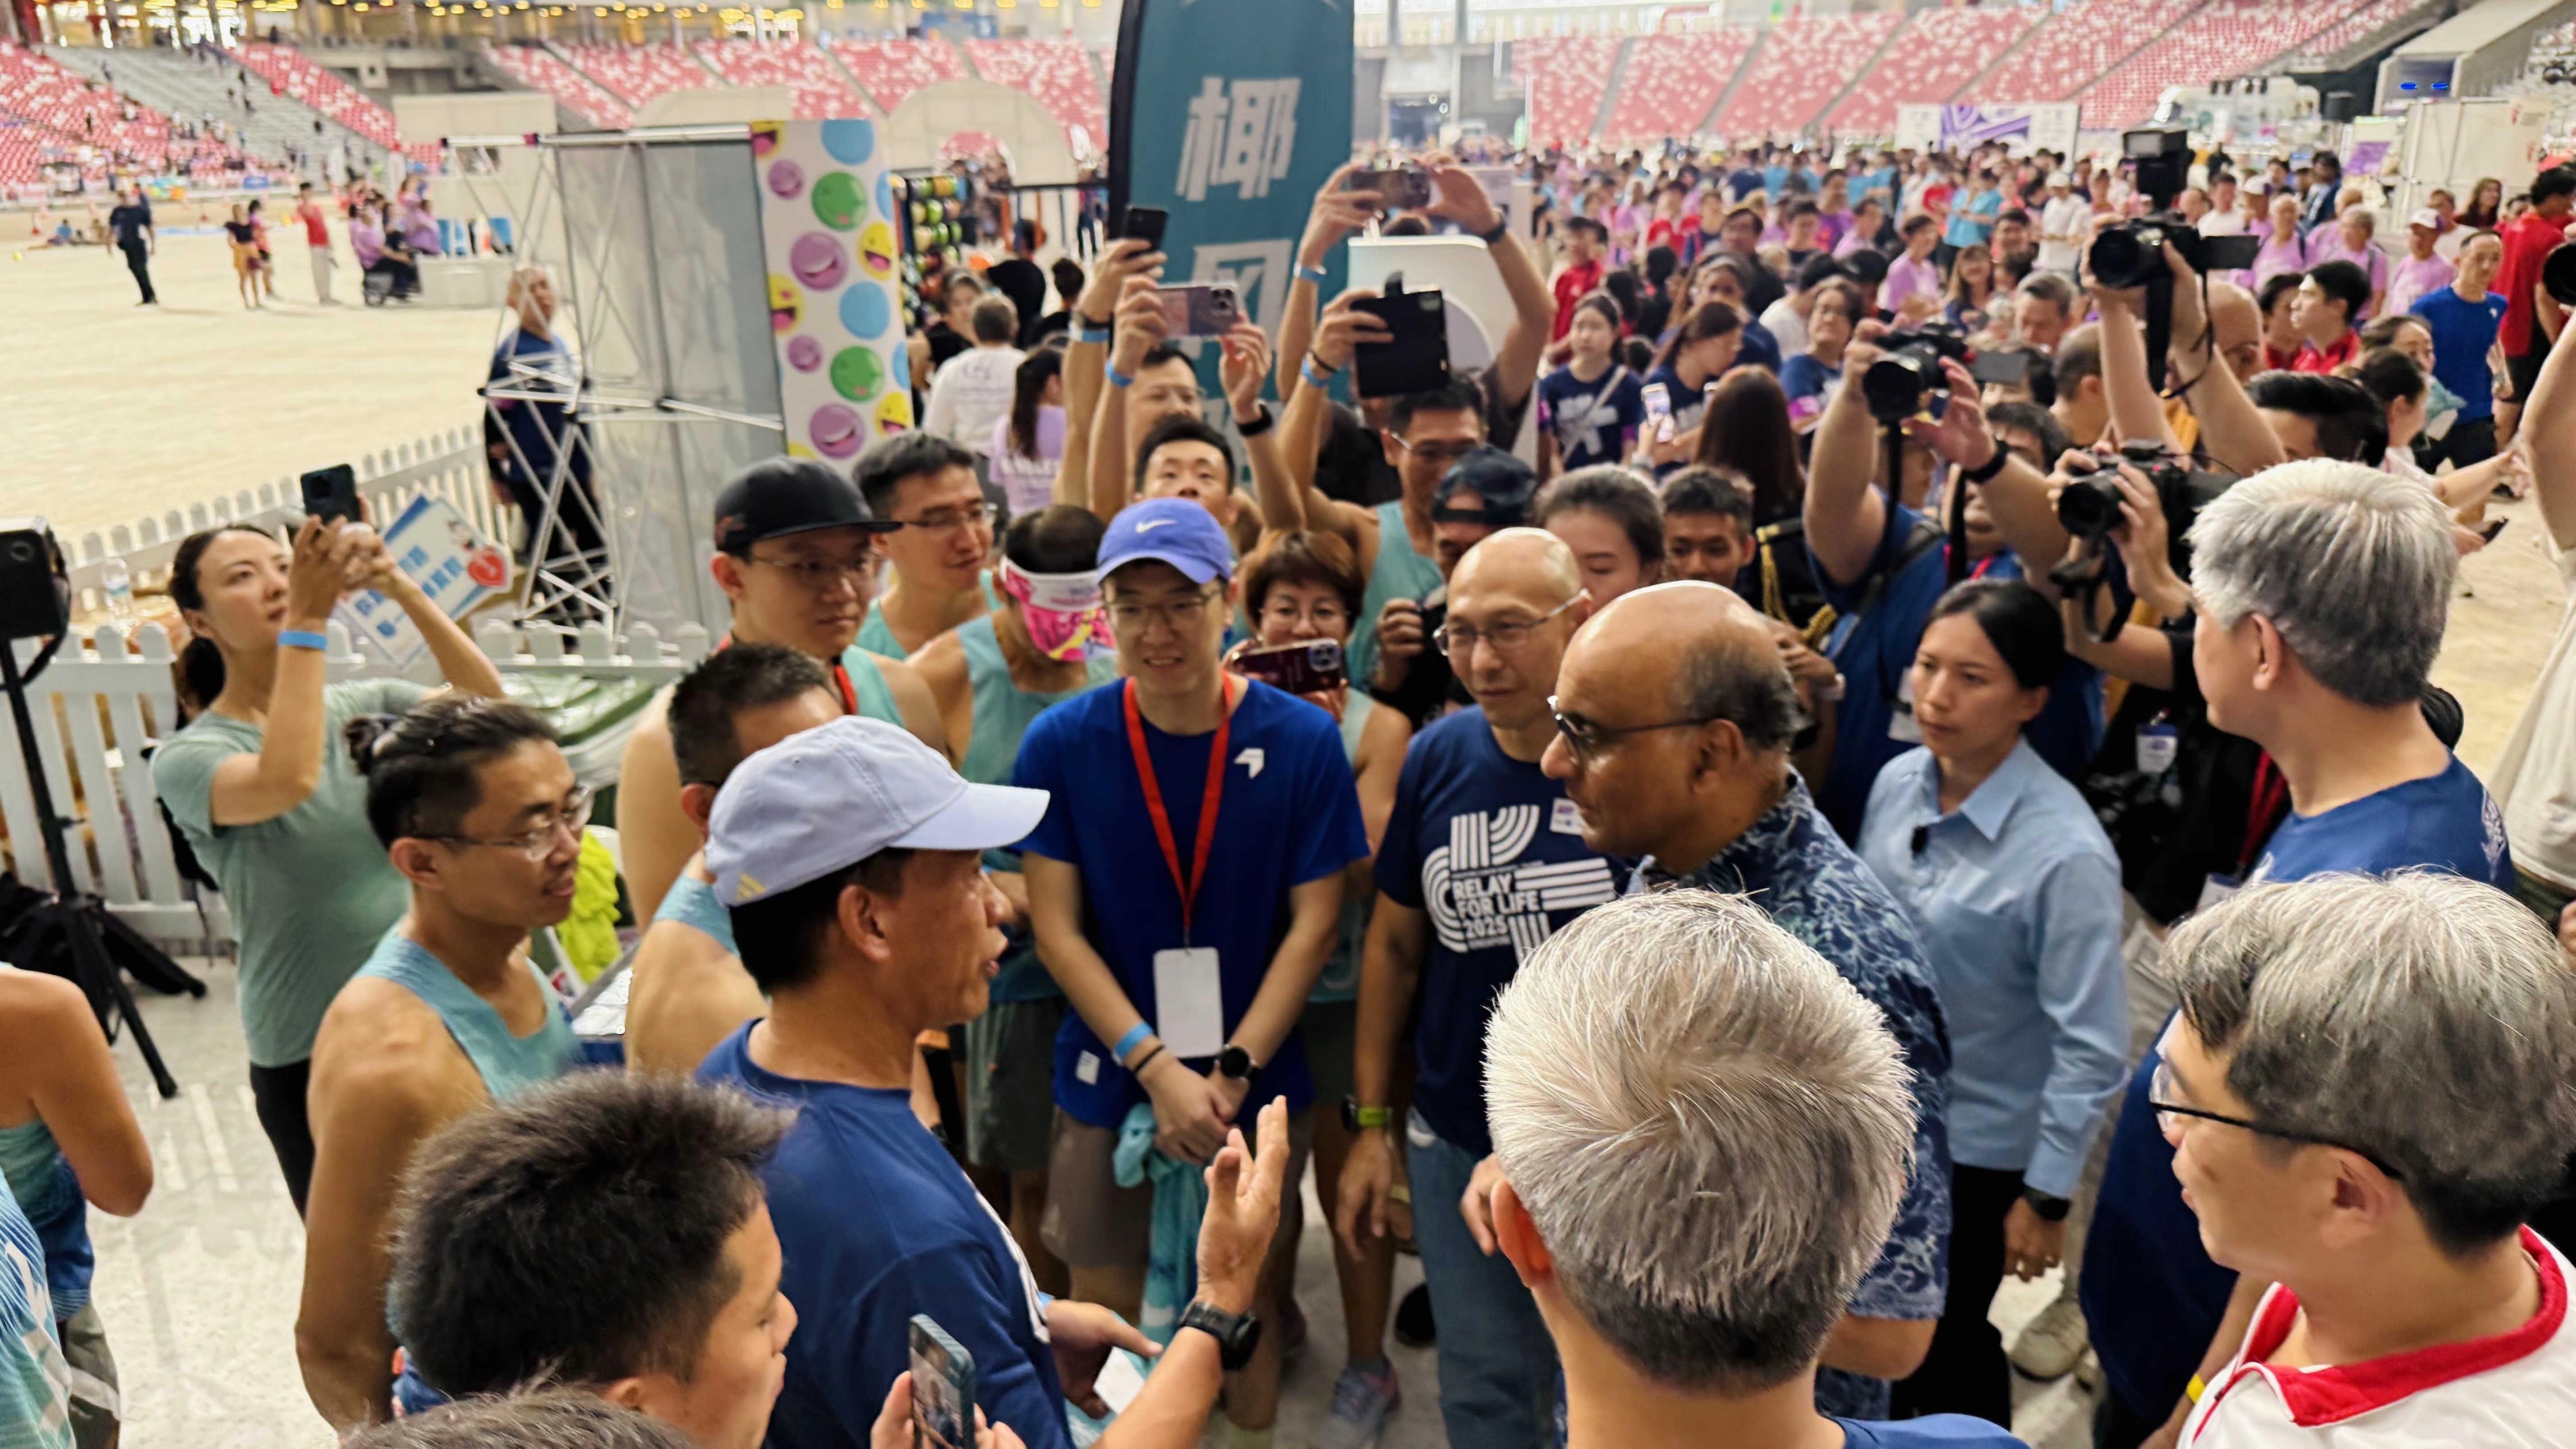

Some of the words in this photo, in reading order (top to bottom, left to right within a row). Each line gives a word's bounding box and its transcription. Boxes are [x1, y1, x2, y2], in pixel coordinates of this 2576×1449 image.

[1452, 873, 1512, 900] RELAY
[1457, 896, 1495, 920] FOR
[1496, 890, 1540, 916] LIFE
[1463, 915, 1509, 939] 2025
